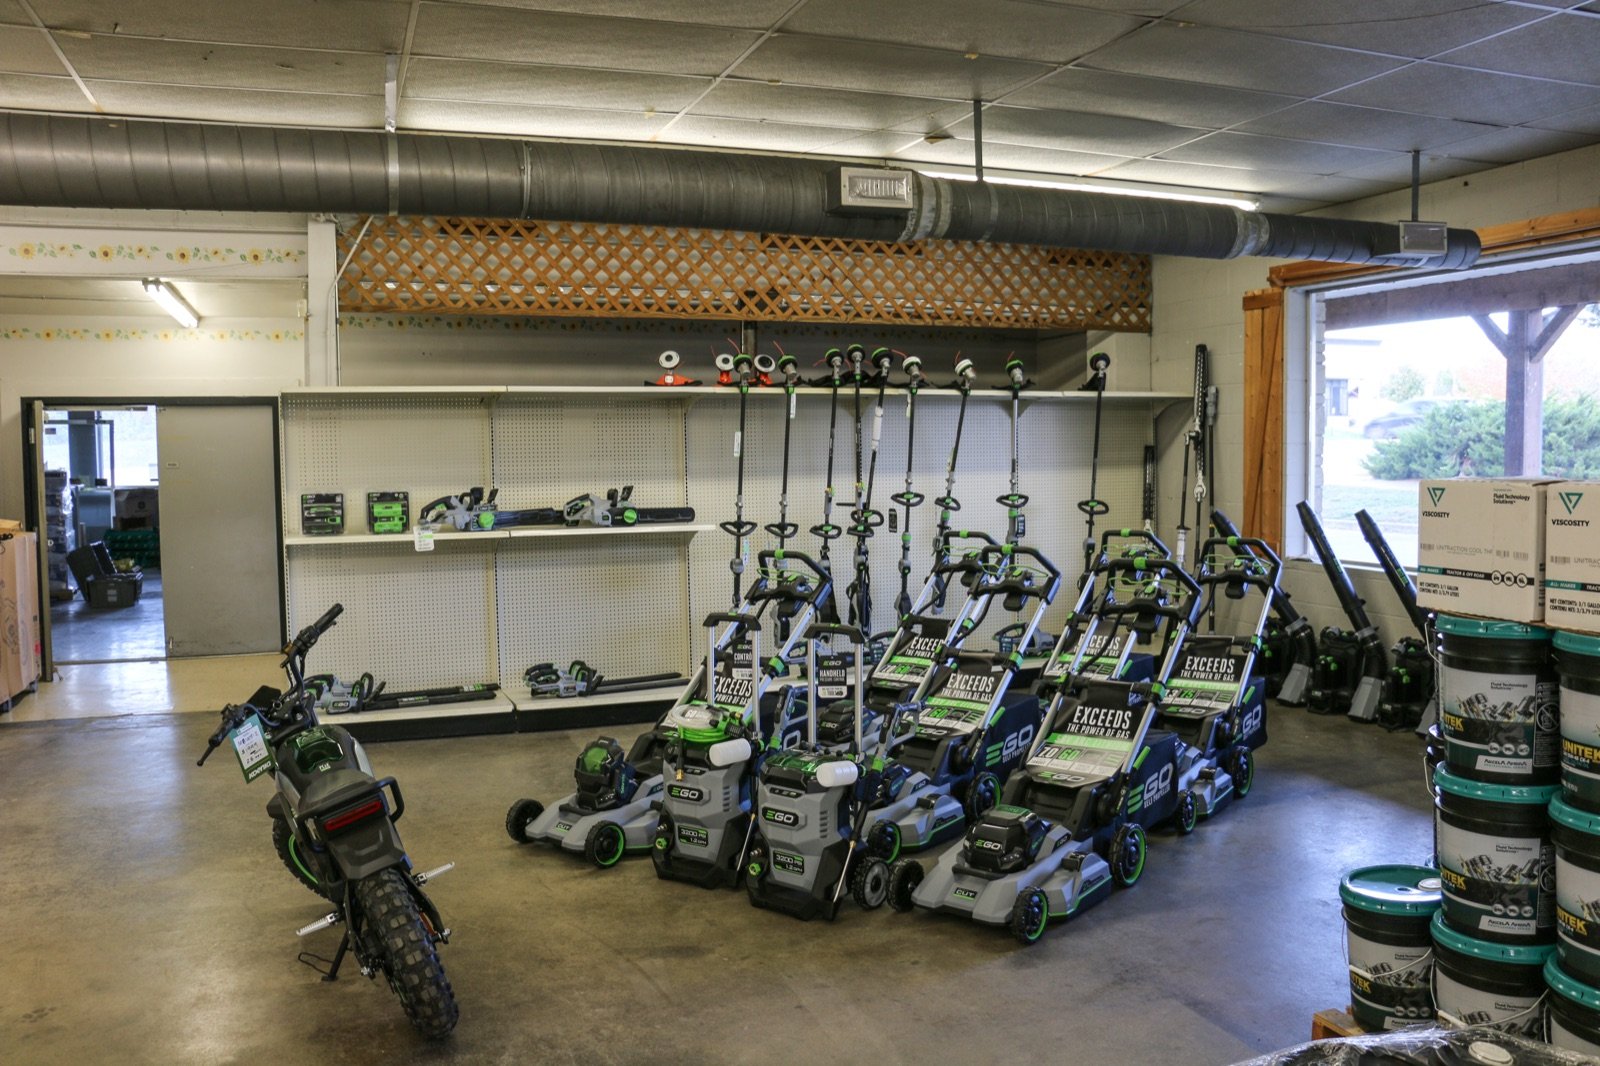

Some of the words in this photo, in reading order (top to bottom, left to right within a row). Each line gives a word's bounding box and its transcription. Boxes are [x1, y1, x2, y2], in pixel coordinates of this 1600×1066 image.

[1422, 511, 1450, 519] VISCOSITY
[1551, 518, 1590, 527] VISCOSITY
[910, 637, 945, 651] EXCEE
[914, 650, 930, 658] POWER
[1185, 656, 1236, 674] EXCEEDS
[819, 669, 845, 678] HANDHELD
[1180, 669, 1190, 677] THE
[1191, 671, 1212, 680] POWER
[1214, 673, 1222, 681] OF
[1222, 674, 1235, 682] GAS
[946, 673, 995, 693] EXCEEDS
[715, 693, 731, 703] POWER
[941, 688, 952, 696] THE
[952, 689, 972, 699] POWER
[972, 692, 980, 700] OF
[980, 693, 993, 701] GAS
[1072, 705, 1132, 730] EXCEEDS
[1067, 723, 1080, 733] THE
[1081, 725, 1105, 736] POWER
[1105, 729, 1115, 738] OF
[1116, 730, 1130, 740] GAS
[985, 724, 1034, 768] EGO
[1058, 748, 1081, 761] 60
[1038, 771, 1085, 782] EGO
[671, 786, 699, 799] EGO
[1127, 762, 1174, 814] EGO
[766, 809, 794, 823] EGO
[681, 828, 698, 837] 3200
[975, 839, 1001, 850] EGO
[776, 854, 794, 864] 3200
[1557, 906, 1587, 935] NITEK
